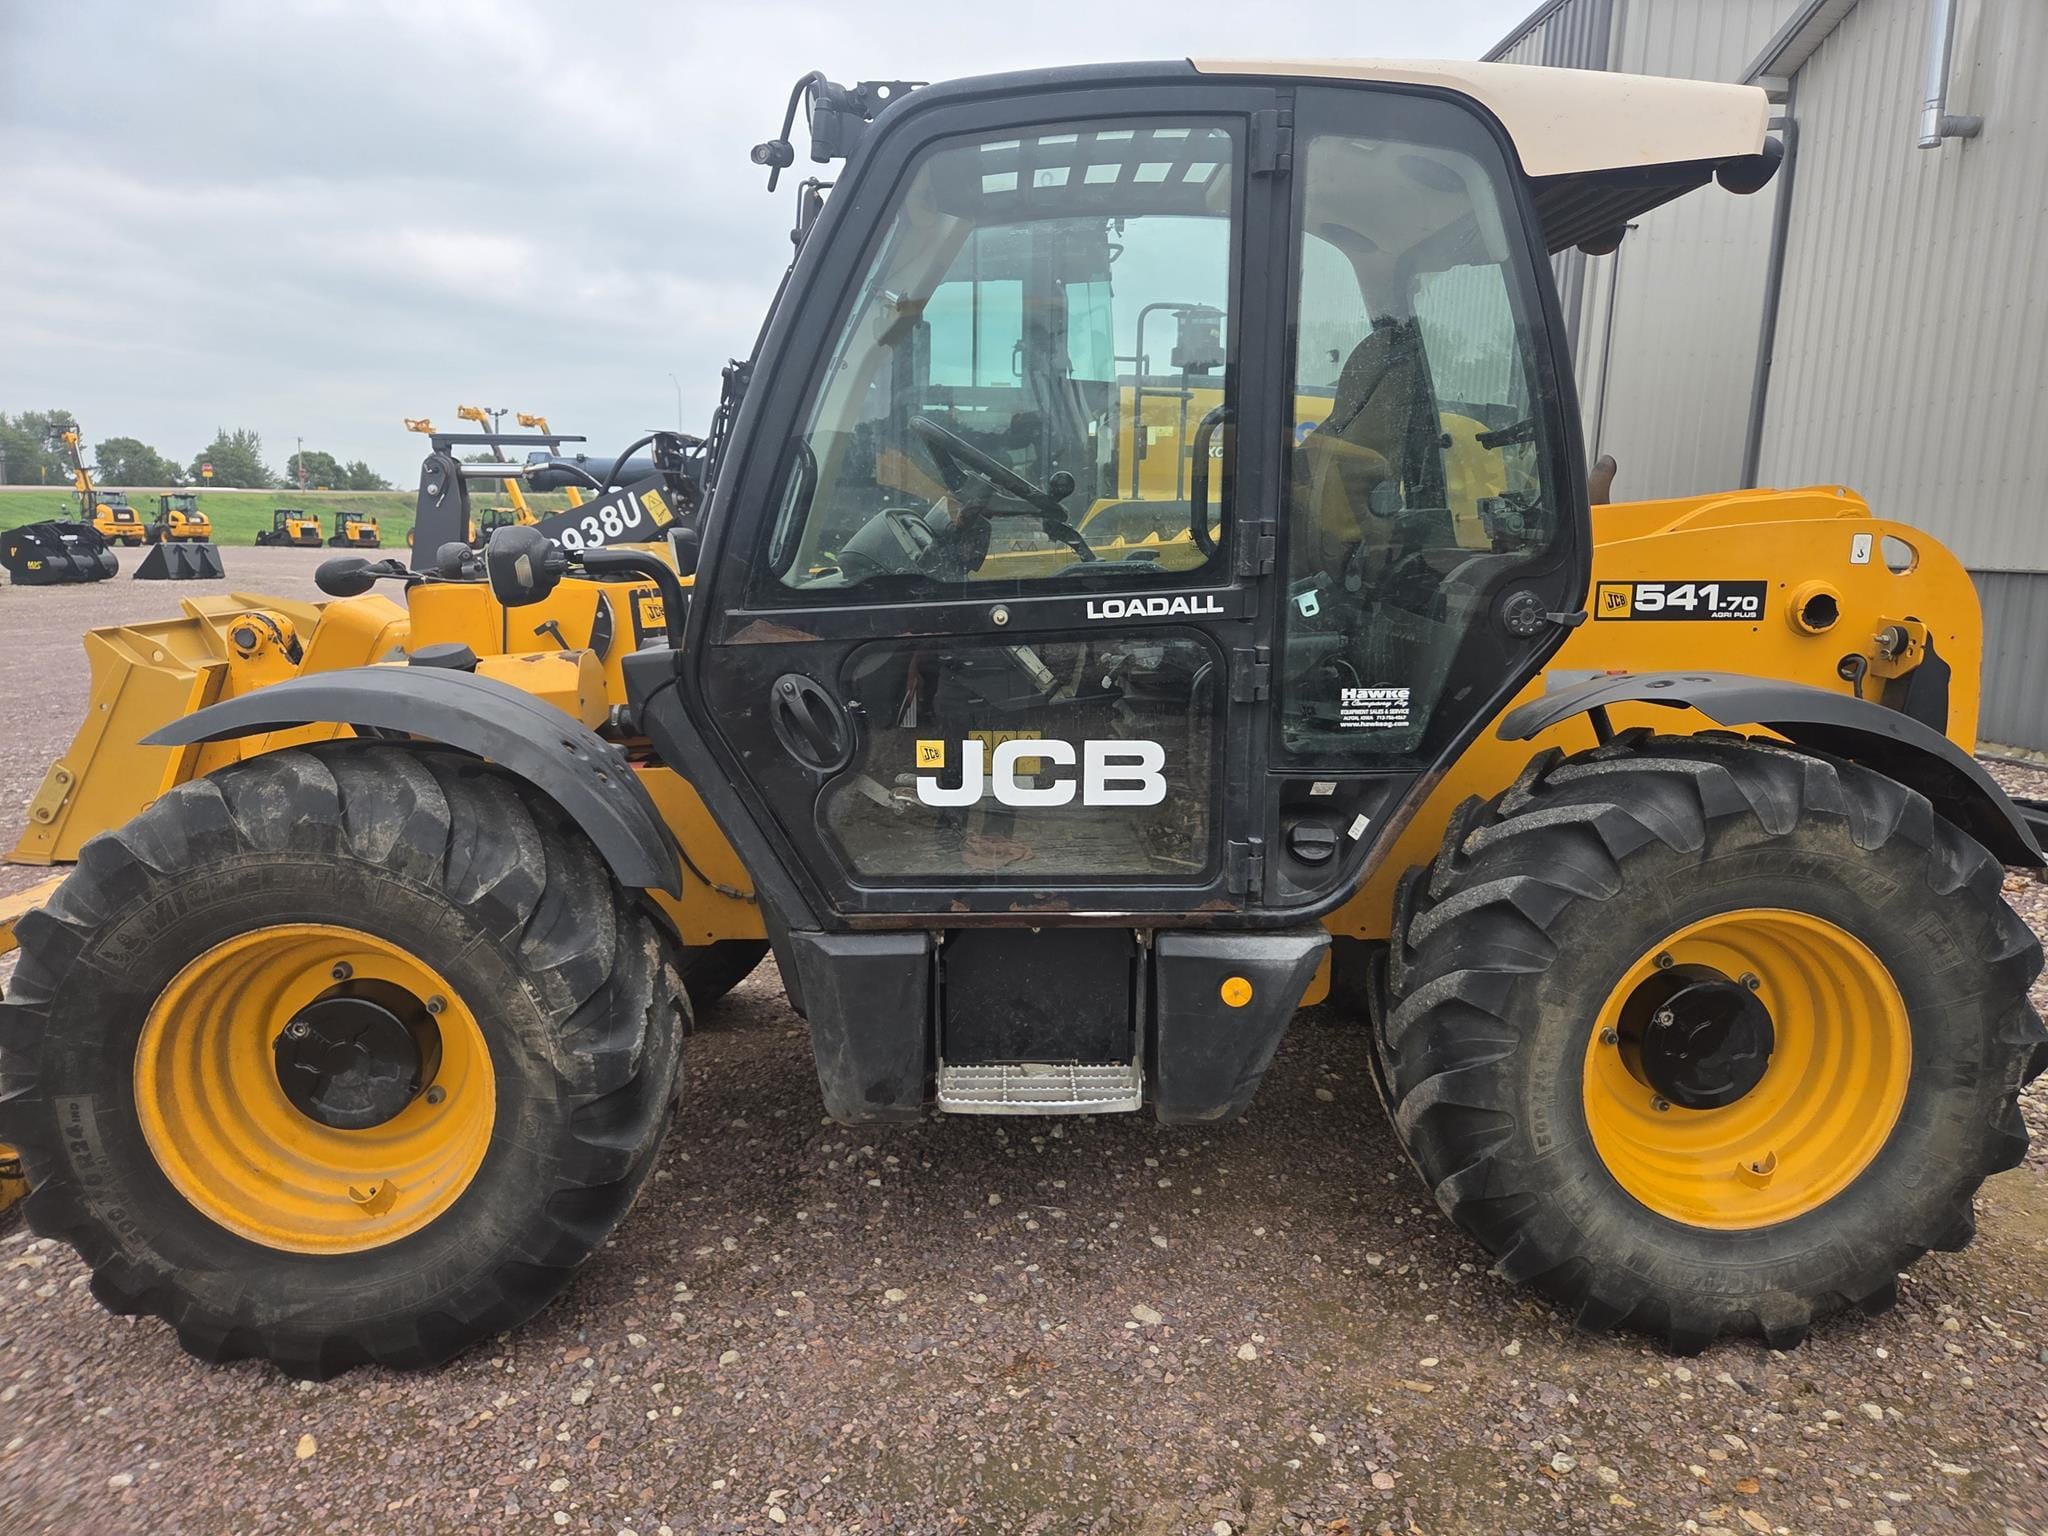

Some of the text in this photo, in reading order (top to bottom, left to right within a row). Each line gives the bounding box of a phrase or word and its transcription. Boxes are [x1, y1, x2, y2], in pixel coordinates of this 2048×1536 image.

[1087, 595, 1225, 619] LOADALL
[1607, 593, 1626, 609] JCB
[1634, 584, 1758, 611] 541-70
[1341, 688, 1410, 699] Hawke
[923, 746, 940, 761] JCB
[917, 740, 1167, 807] JCB
